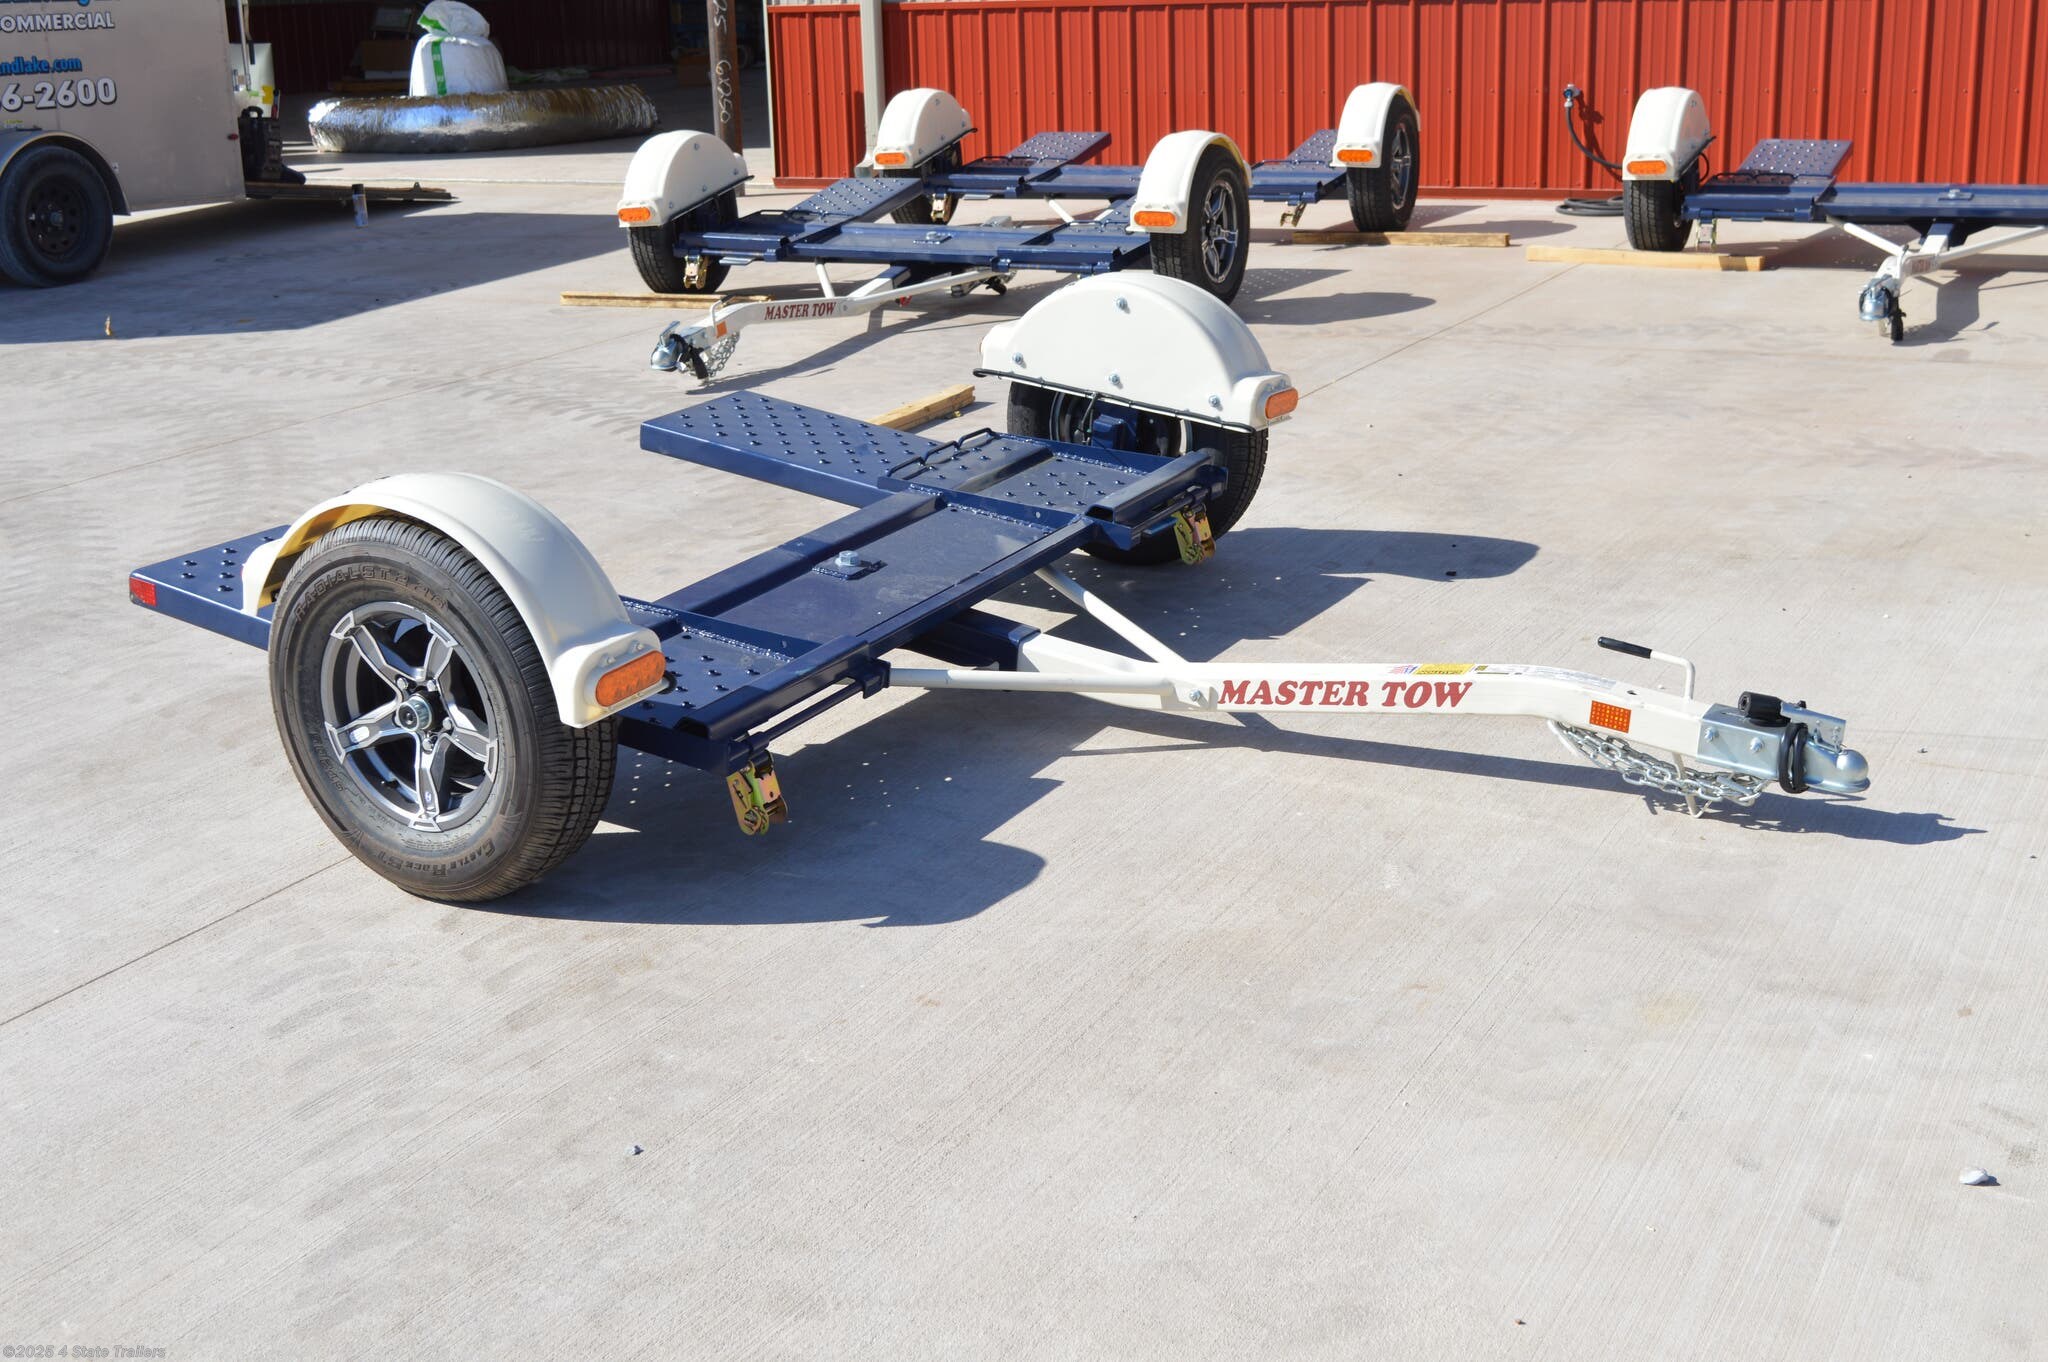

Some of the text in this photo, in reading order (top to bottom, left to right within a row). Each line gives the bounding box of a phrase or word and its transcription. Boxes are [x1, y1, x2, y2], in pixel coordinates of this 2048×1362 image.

[0, 12, 115, 33] OMMERCIAL
[0, 55, 83, 76] ndlake.com
[0, 78, 118, 112] 6-2600
[764, 302, 837, 320] MASTER TOW
[1217, 680, 1473, 708] MASTER TOW
